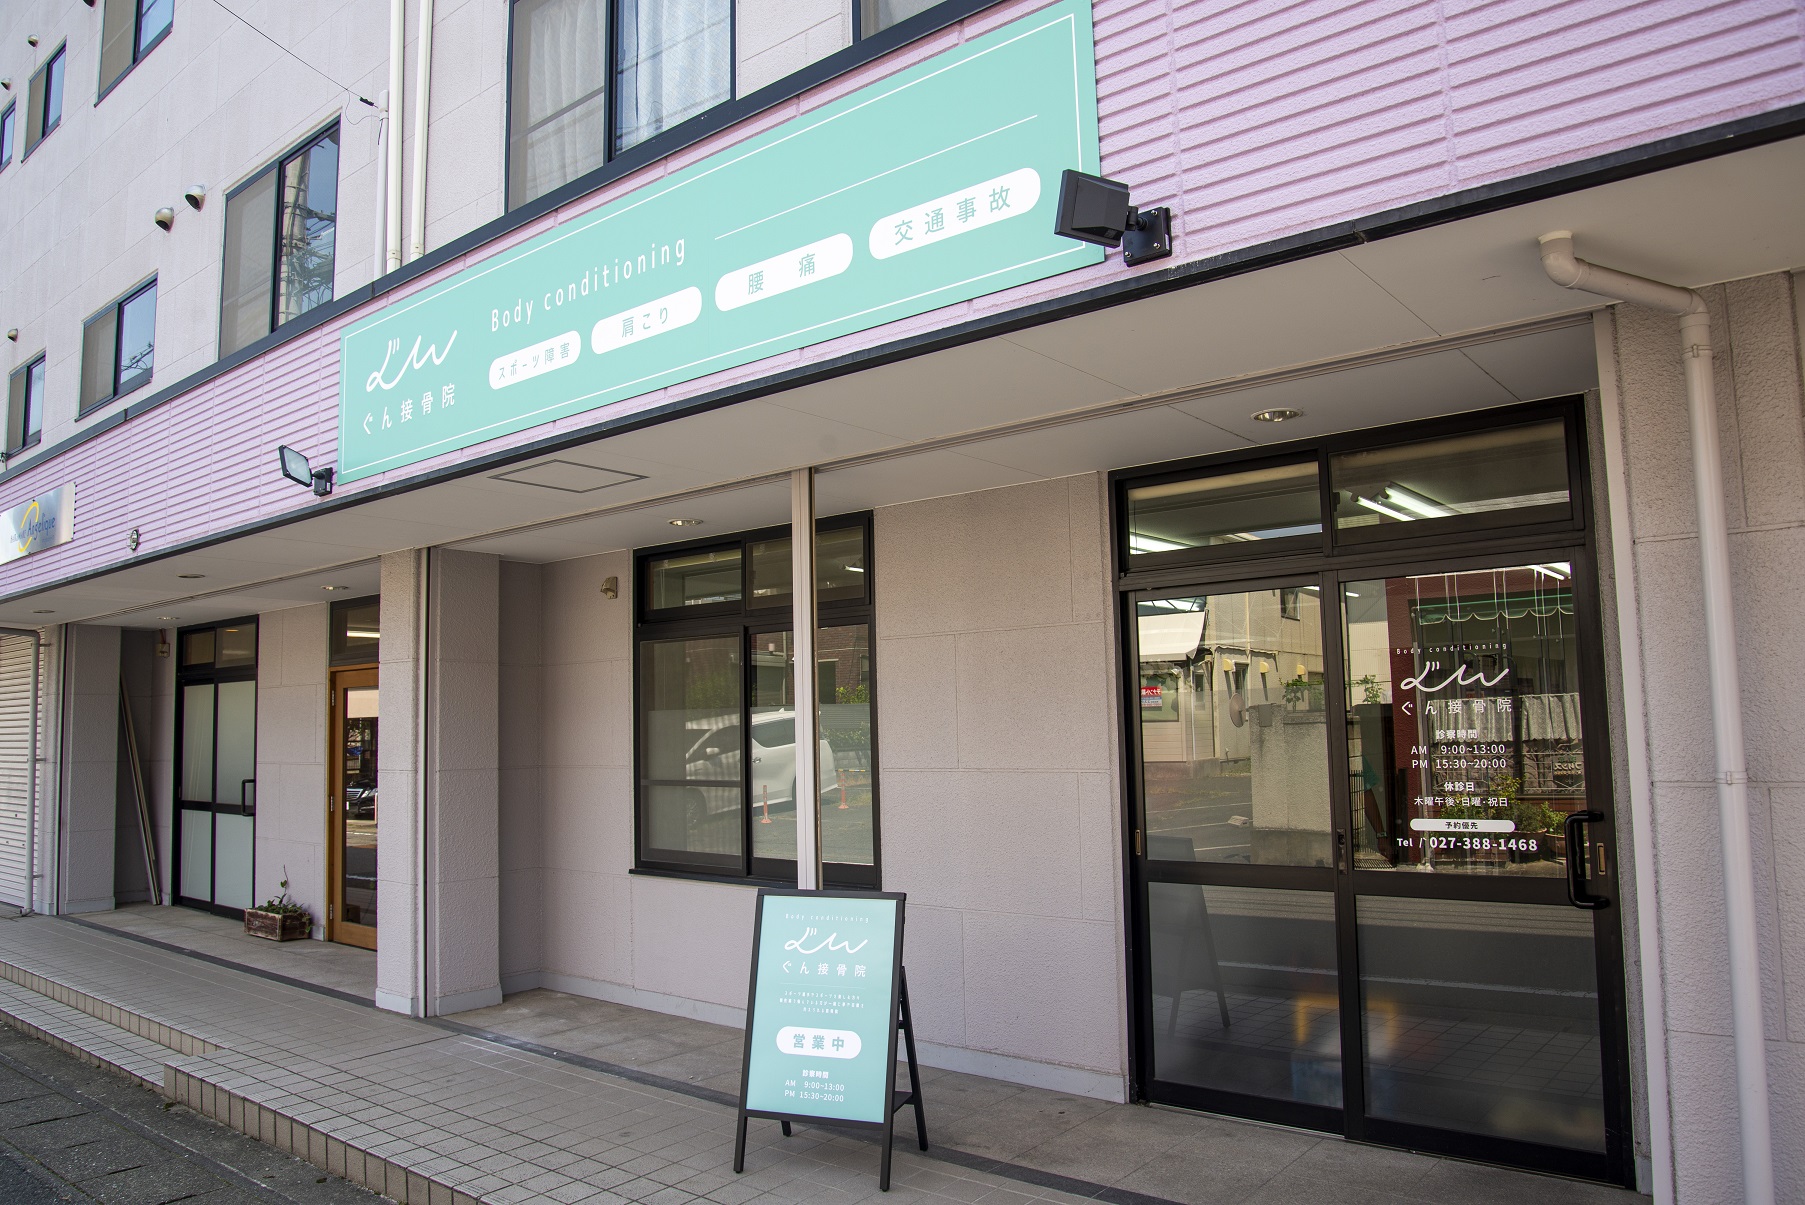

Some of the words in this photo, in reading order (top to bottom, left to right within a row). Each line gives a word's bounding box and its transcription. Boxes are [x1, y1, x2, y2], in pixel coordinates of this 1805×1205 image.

[491, 302, 534, 333] Body
[544, 236, 686, 311] conditioning
[498, 341, 572, 382] スポーツ障害
[621, 305, 669, 340] 肩こり
[894, 185, 1012, 247] 交通事故
[362, 382, 456, 436] ぐん接骨院
[27, 513, 56, 540] Angelique
[1396, 646, 1422, 655] Body
[1429, 642, 1507, 653] conditioning
[1401, 698, 1512, 716] ぐん接骨院
[1436, 729, 1478, 740] 診察時間
[1411, 745, 1427, 755] AM
[1412, 759, 1428, 769] PM
[1444, 782, 1475, 792] 休診日
[1445, 821, 1479, 830] 予約優先
[1396, 837, 1413, 847] Tel
[1430, 837, 1538, 851] 027-388-1468
[785, 912, 805, 922] Body
[810, 914, 870, 924] conditioning
[782, 960, 866, 978] ぐん接骨院
[793, 1033, 845, 1052] 営業中
[802, 1069, 829, 1079] 診察時間
[785, 1079, 796, 1087] AM
[784, 1090, 795, 1098] PM
